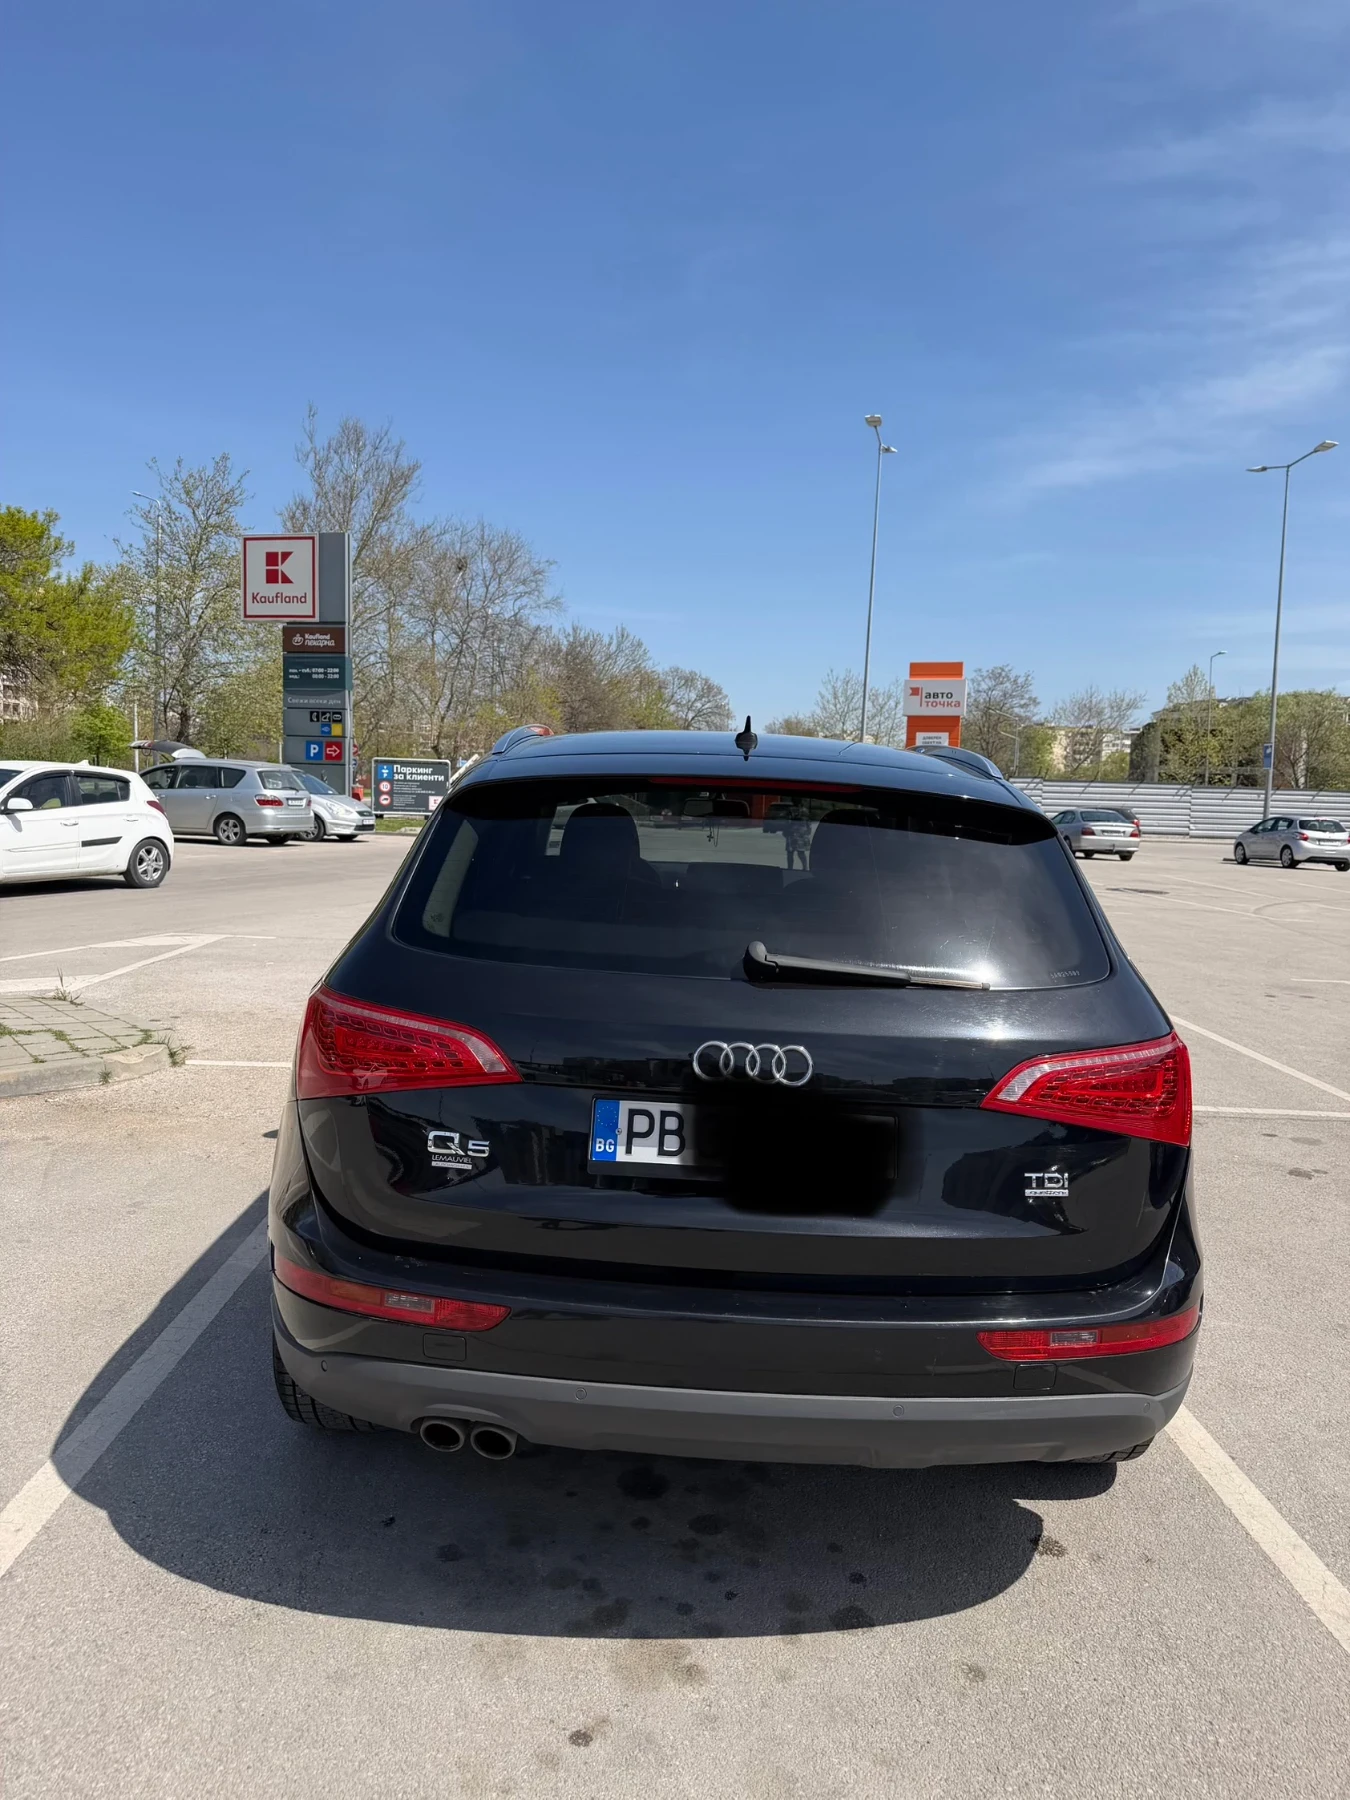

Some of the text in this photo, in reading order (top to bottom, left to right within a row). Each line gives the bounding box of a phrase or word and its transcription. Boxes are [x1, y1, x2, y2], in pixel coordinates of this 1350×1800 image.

[251, 592, 307, 604] Kaufland
[924, 700, 961, 708] точка
[310, 744, 319, 757] P
[393, 764, 433, 775] Паркинг
[406, 773, 445, 781] клиенти
[625, 1108, 686, 1157] PB
[427, 1130, 490, 1157] Q5
[595, 1138, 615, 1153] BG
[1024, 1172, 1069, 1188] TDI
